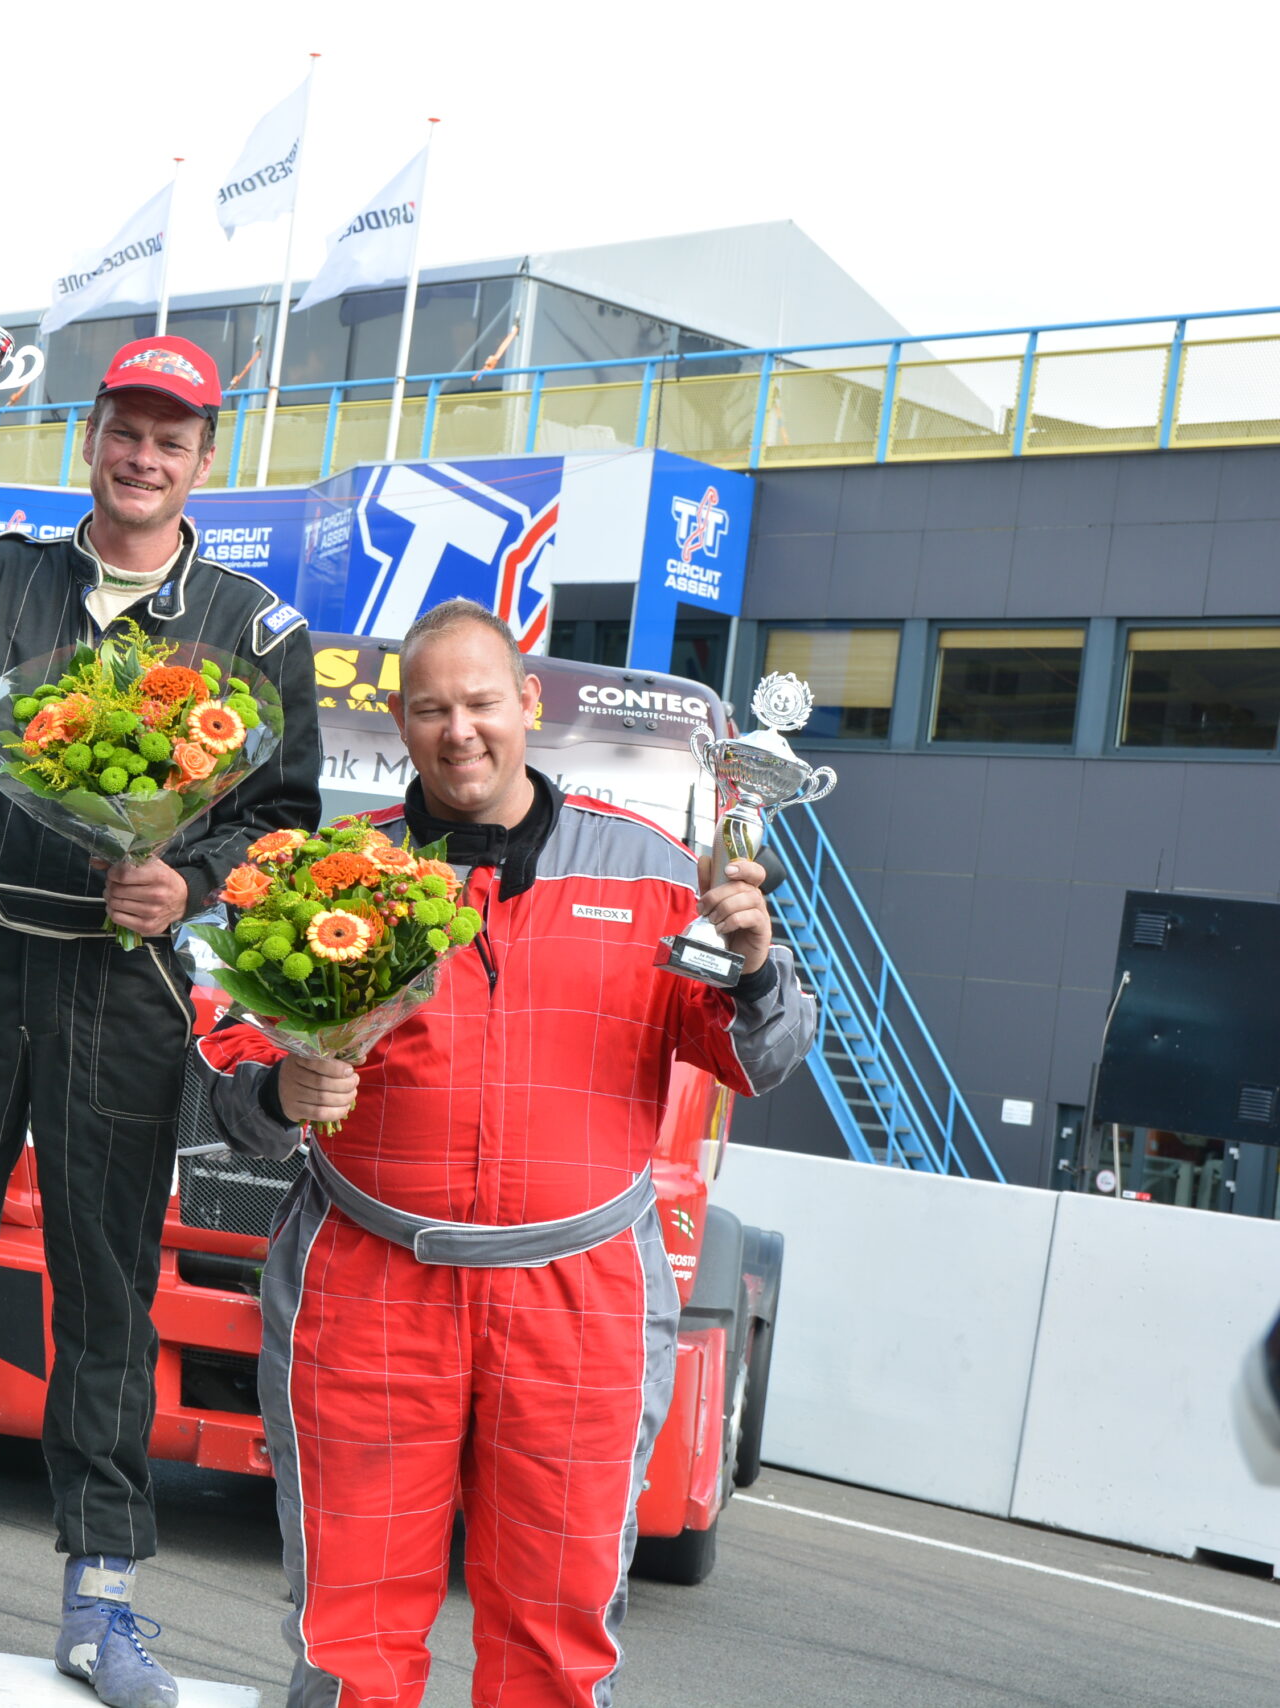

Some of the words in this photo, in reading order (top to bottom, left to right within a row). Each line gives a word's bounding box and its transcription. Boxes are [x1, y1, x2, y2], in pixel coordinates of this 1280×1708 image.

[322, 508, 353, 531] CIRCUIT
[205, 527, 273, 544] CIRCUIT
[320, 525, 351, 550] ASSEN
[203, 544, 271, 560] ASSEN
[666, 558, 722, 585] CIRCUIT
[664, 574, 720, 600] ASSEN
[318, 696, 337, 708] &
[578, 685, 708, 719] CONTEQ
[578, 705, 709, 728] BEVESTIGINGSTECHNIEKEN
[577, 906, 629, 920] ARROXX
